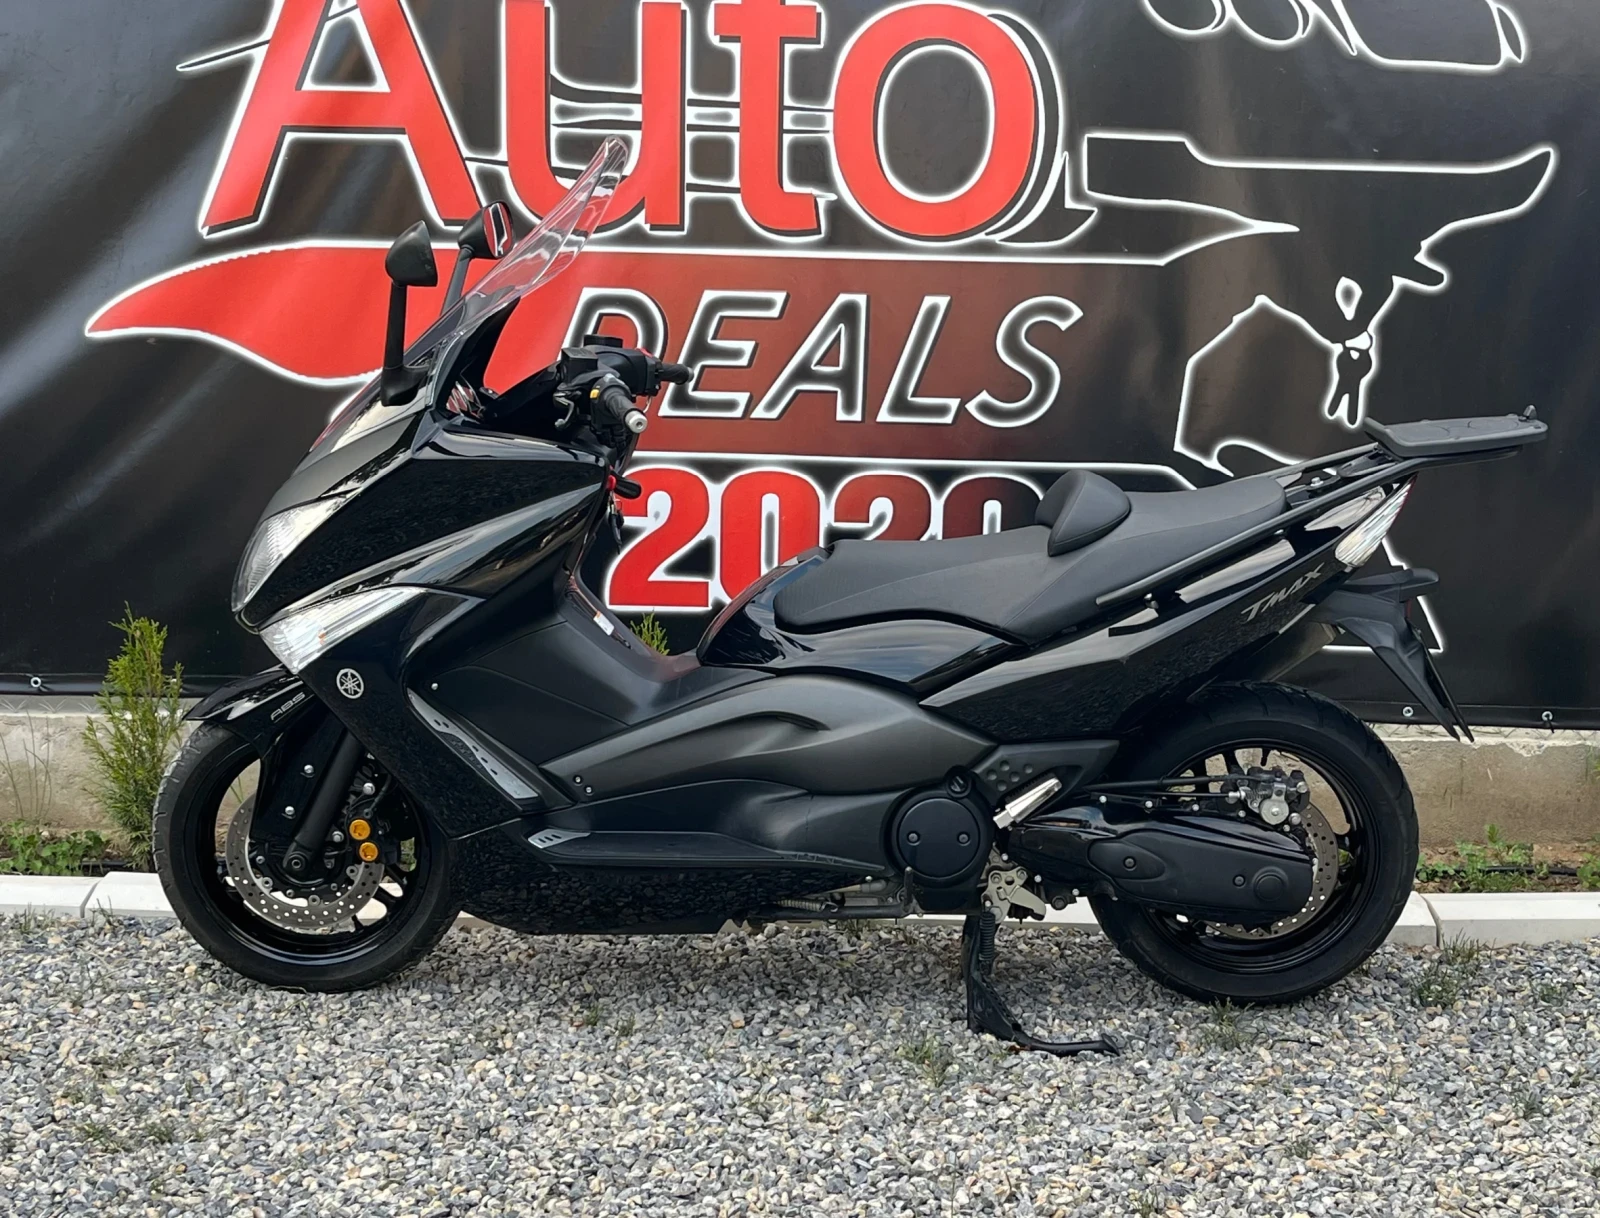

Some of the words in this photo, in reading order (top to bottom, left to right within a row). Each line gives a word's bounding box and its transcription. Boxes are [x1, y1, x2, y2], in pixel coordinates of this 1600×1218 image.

[198, 0, 1050, 242] Auto
[561, 287, 1084, 429] DEALS
[1240, 562, 1325, 623] TMAX
[270, 691, 306, 721] ABS
